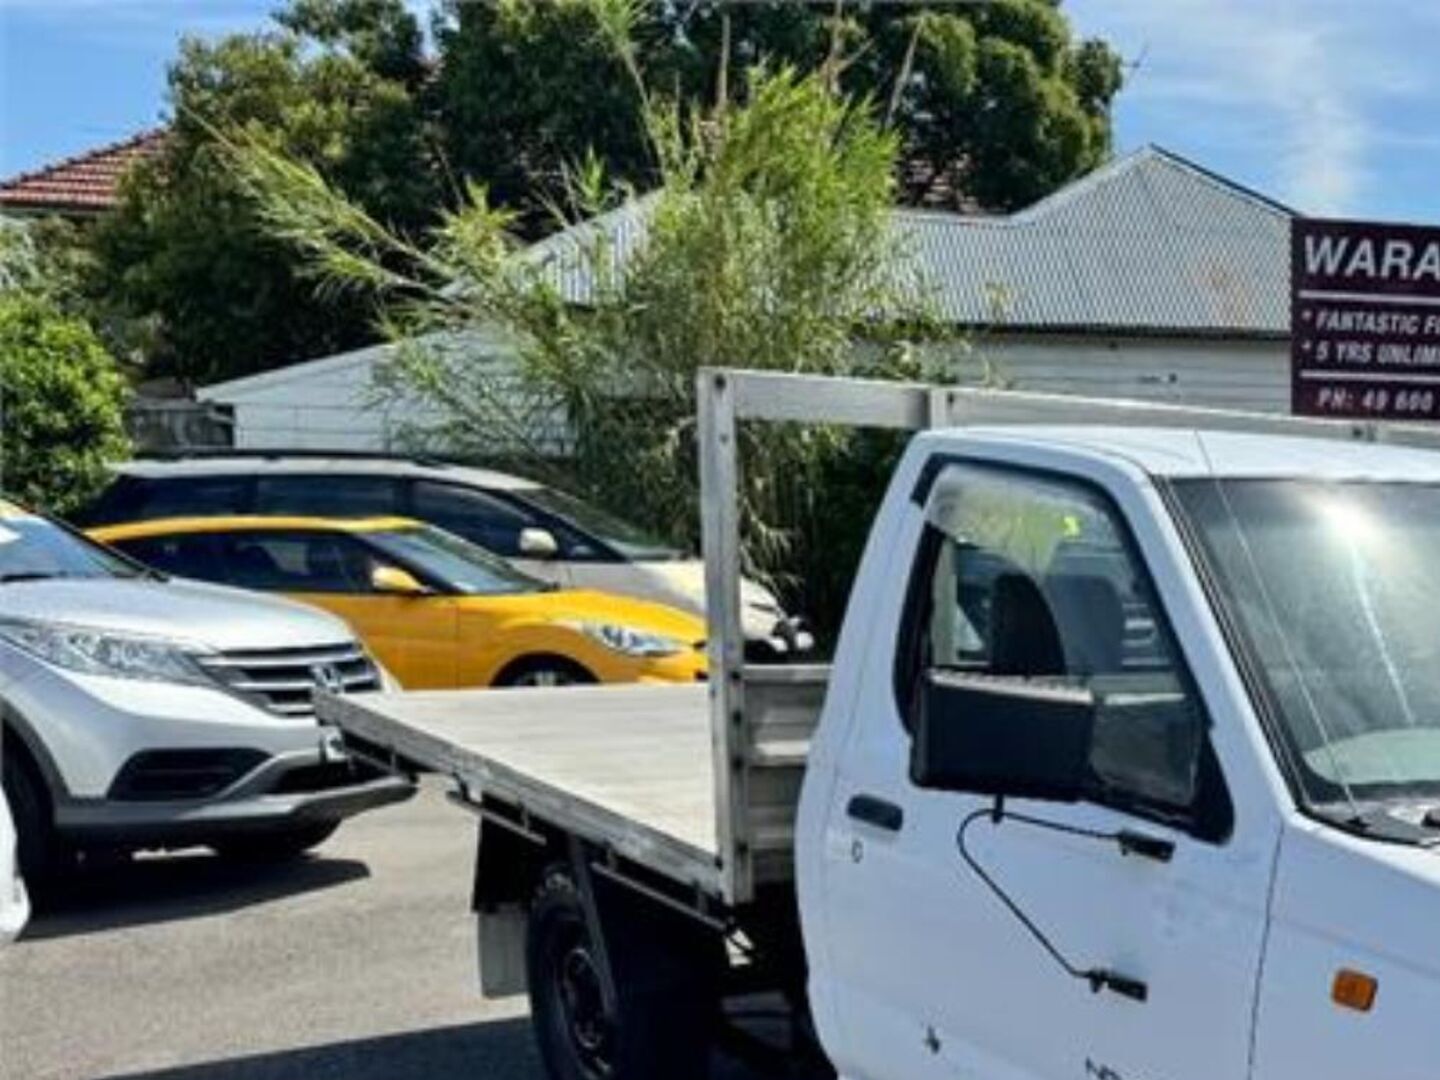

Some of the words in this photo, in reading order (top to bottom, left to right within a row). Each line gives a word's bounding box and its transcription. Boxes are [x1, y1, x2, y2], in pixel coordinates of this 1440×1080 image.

[1316, 309, 1418, 334] FANTASTIC
[1316, 340, 1328, 361] 5
[1337, 342, 1371, 363] YRS
